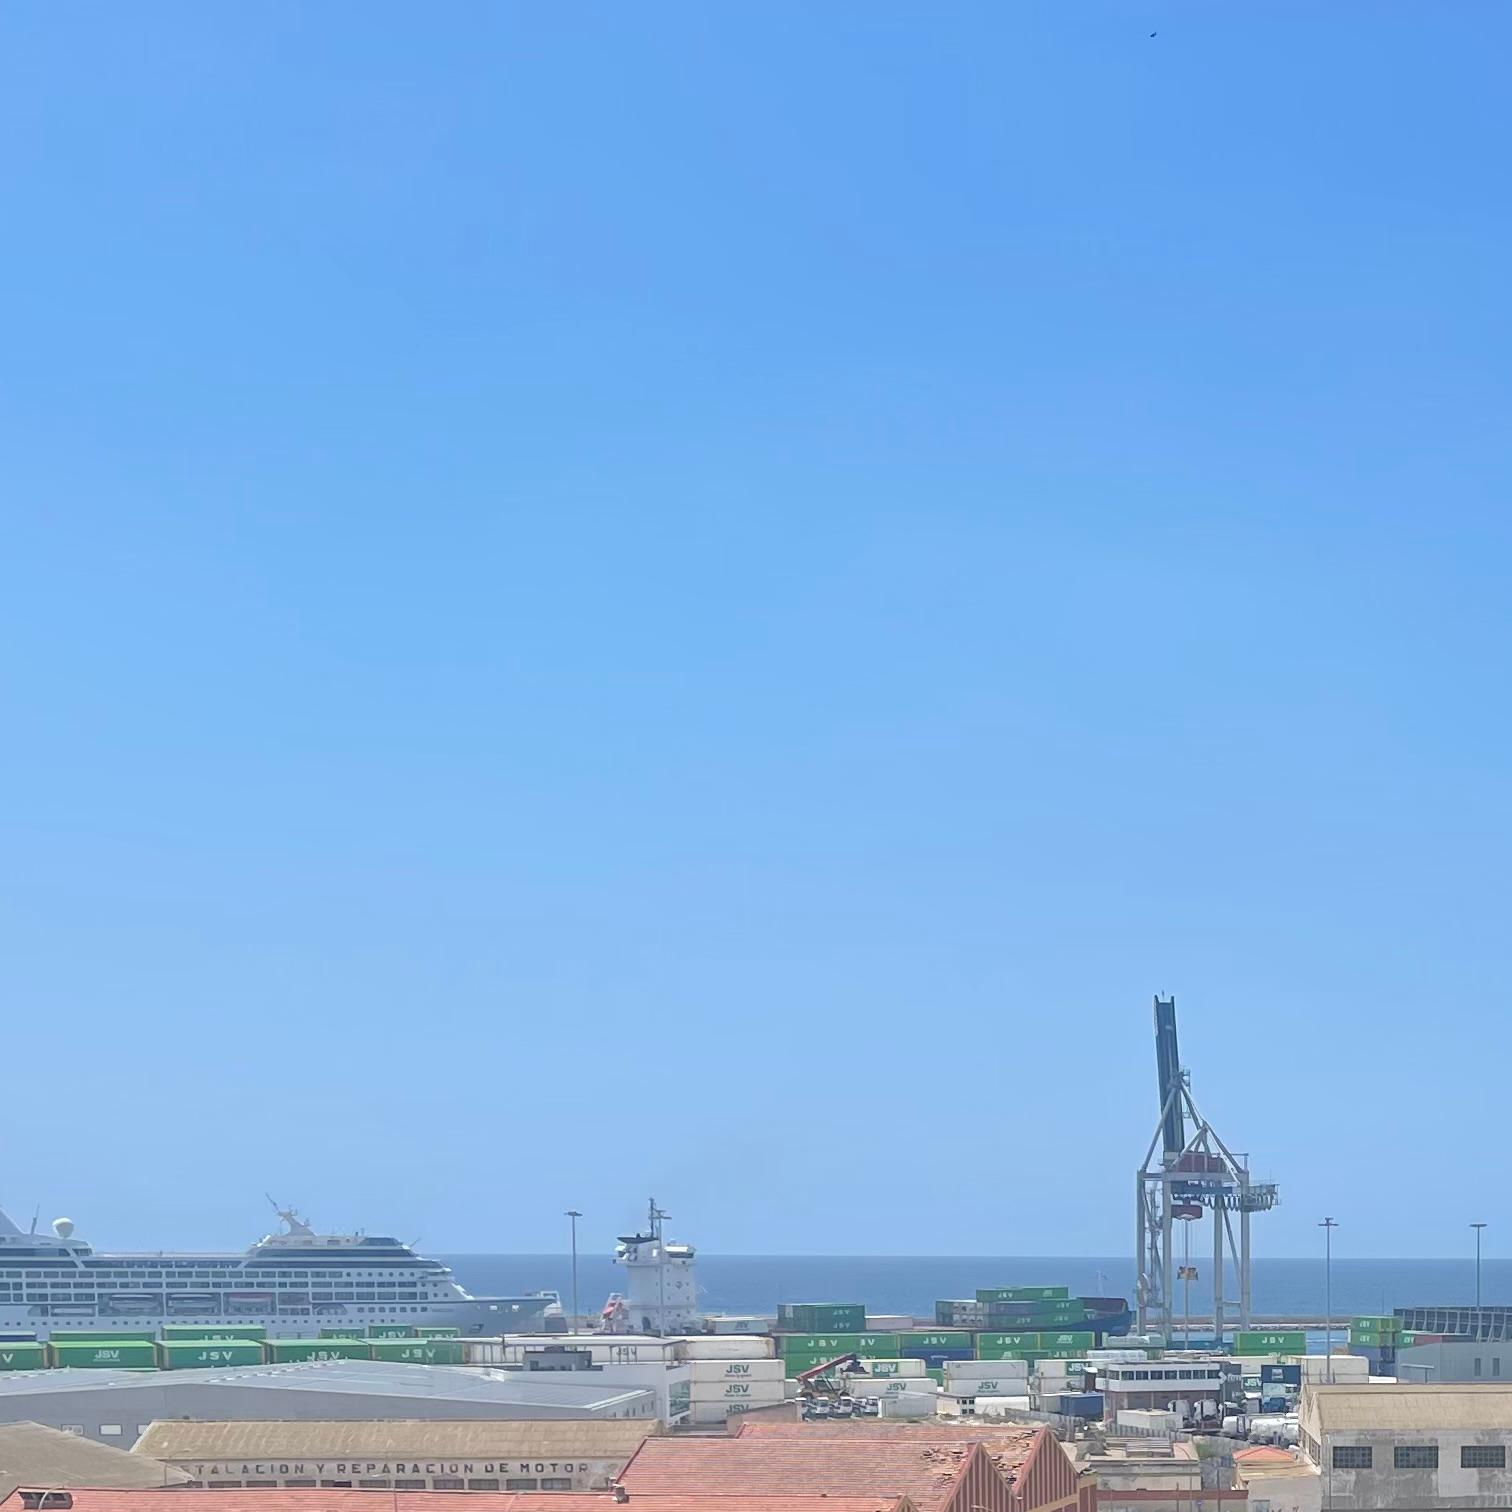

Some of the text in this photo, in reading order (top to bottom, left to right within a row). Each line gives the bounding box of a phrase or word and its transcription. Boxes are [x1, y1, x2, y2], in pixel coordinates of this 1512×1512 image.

[808, 1339, 838, 1347] JSV
[923, 1336, 947, 1344] JSV
[996, 1336, 1020, 1344] JSV
[1261, 1336, 1285, 1344] JSV
[95, 1350, 119, 1359] JSV
[198, 1351, 233, 1360] JSV
[402, 1349, 436, 1358] JSV
[726, 1364, 750, 1374] JSV
[874, 1363, 897, 1373] JSV
[726, 1384, 750, 1393] JSV
[887, 1382, 907, 1391] JSV
[977, 1381, 998, 1389] JSV
[726, 1404, 750, 1414] JSV
[316, 1463, 325, 1474] Y
[337, 1463, 474, 1474] REPARACION
[484, 1463, 509, 1473] DE
